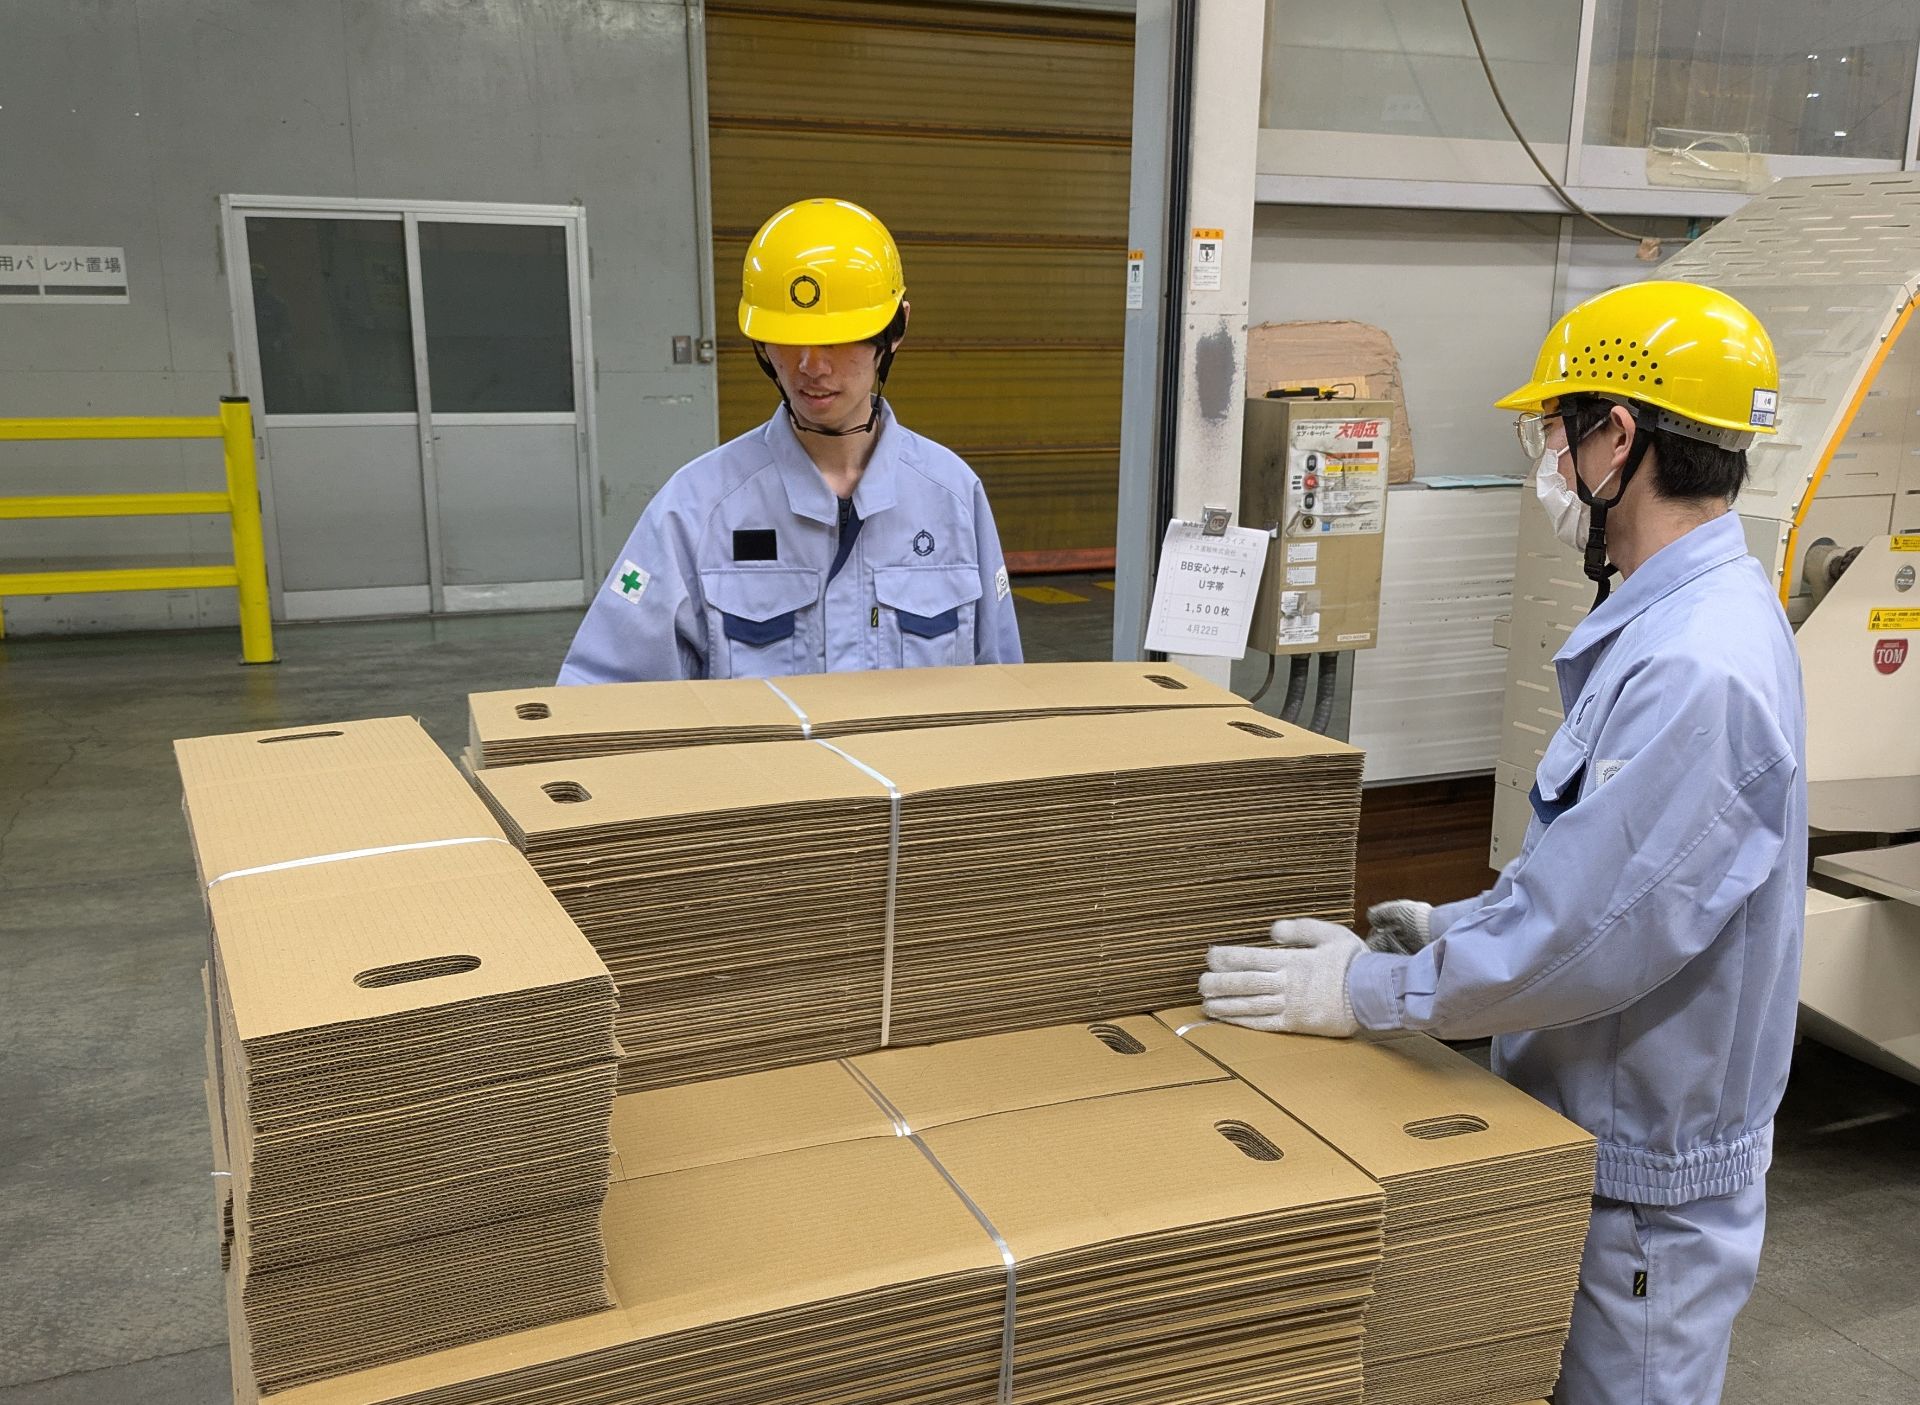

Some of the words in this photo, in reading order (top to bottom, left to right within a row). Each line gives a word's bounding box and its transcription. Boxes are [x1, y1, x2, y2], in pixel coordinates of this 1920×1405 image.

[1180, 560, 1247, 578] BB安心サポート
[1186, 624, 1219, 635] 4月22日
[1876, 648, 1904, 665] TOM
